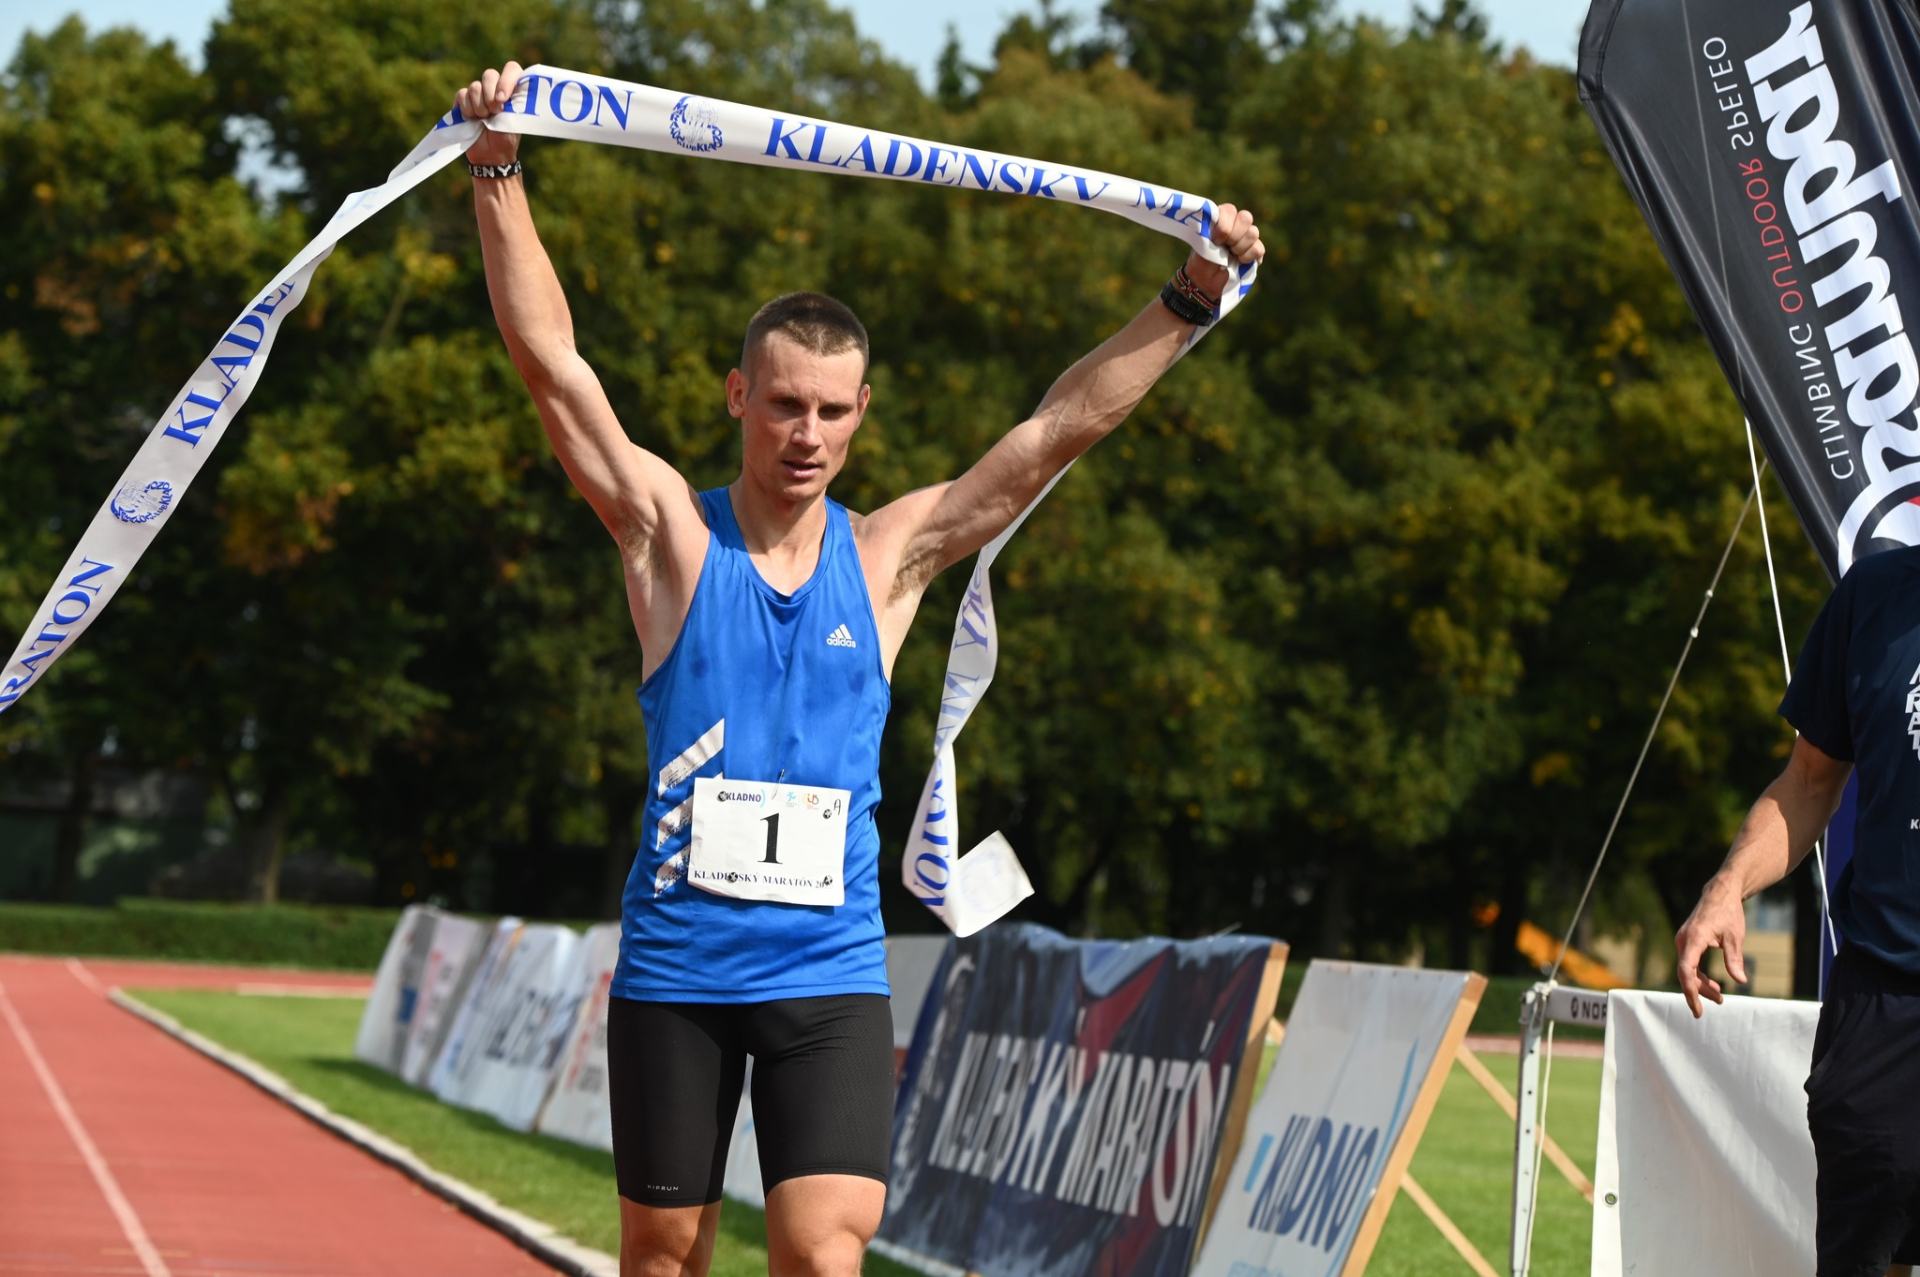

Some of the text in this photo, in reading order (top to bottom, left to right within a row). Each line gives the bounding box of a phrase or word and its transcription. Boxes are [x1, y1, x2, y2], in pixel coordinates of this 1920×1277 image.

[503, 74, 635, 131] TON
[0, 556, 114, 714] RATON
[826, 637, 856, 648] adidas
[725, 792, 762, 802] KLADNO
[757, 812, 783, 865] 1
[694, 870, 758, 883] KLADSKÝ
